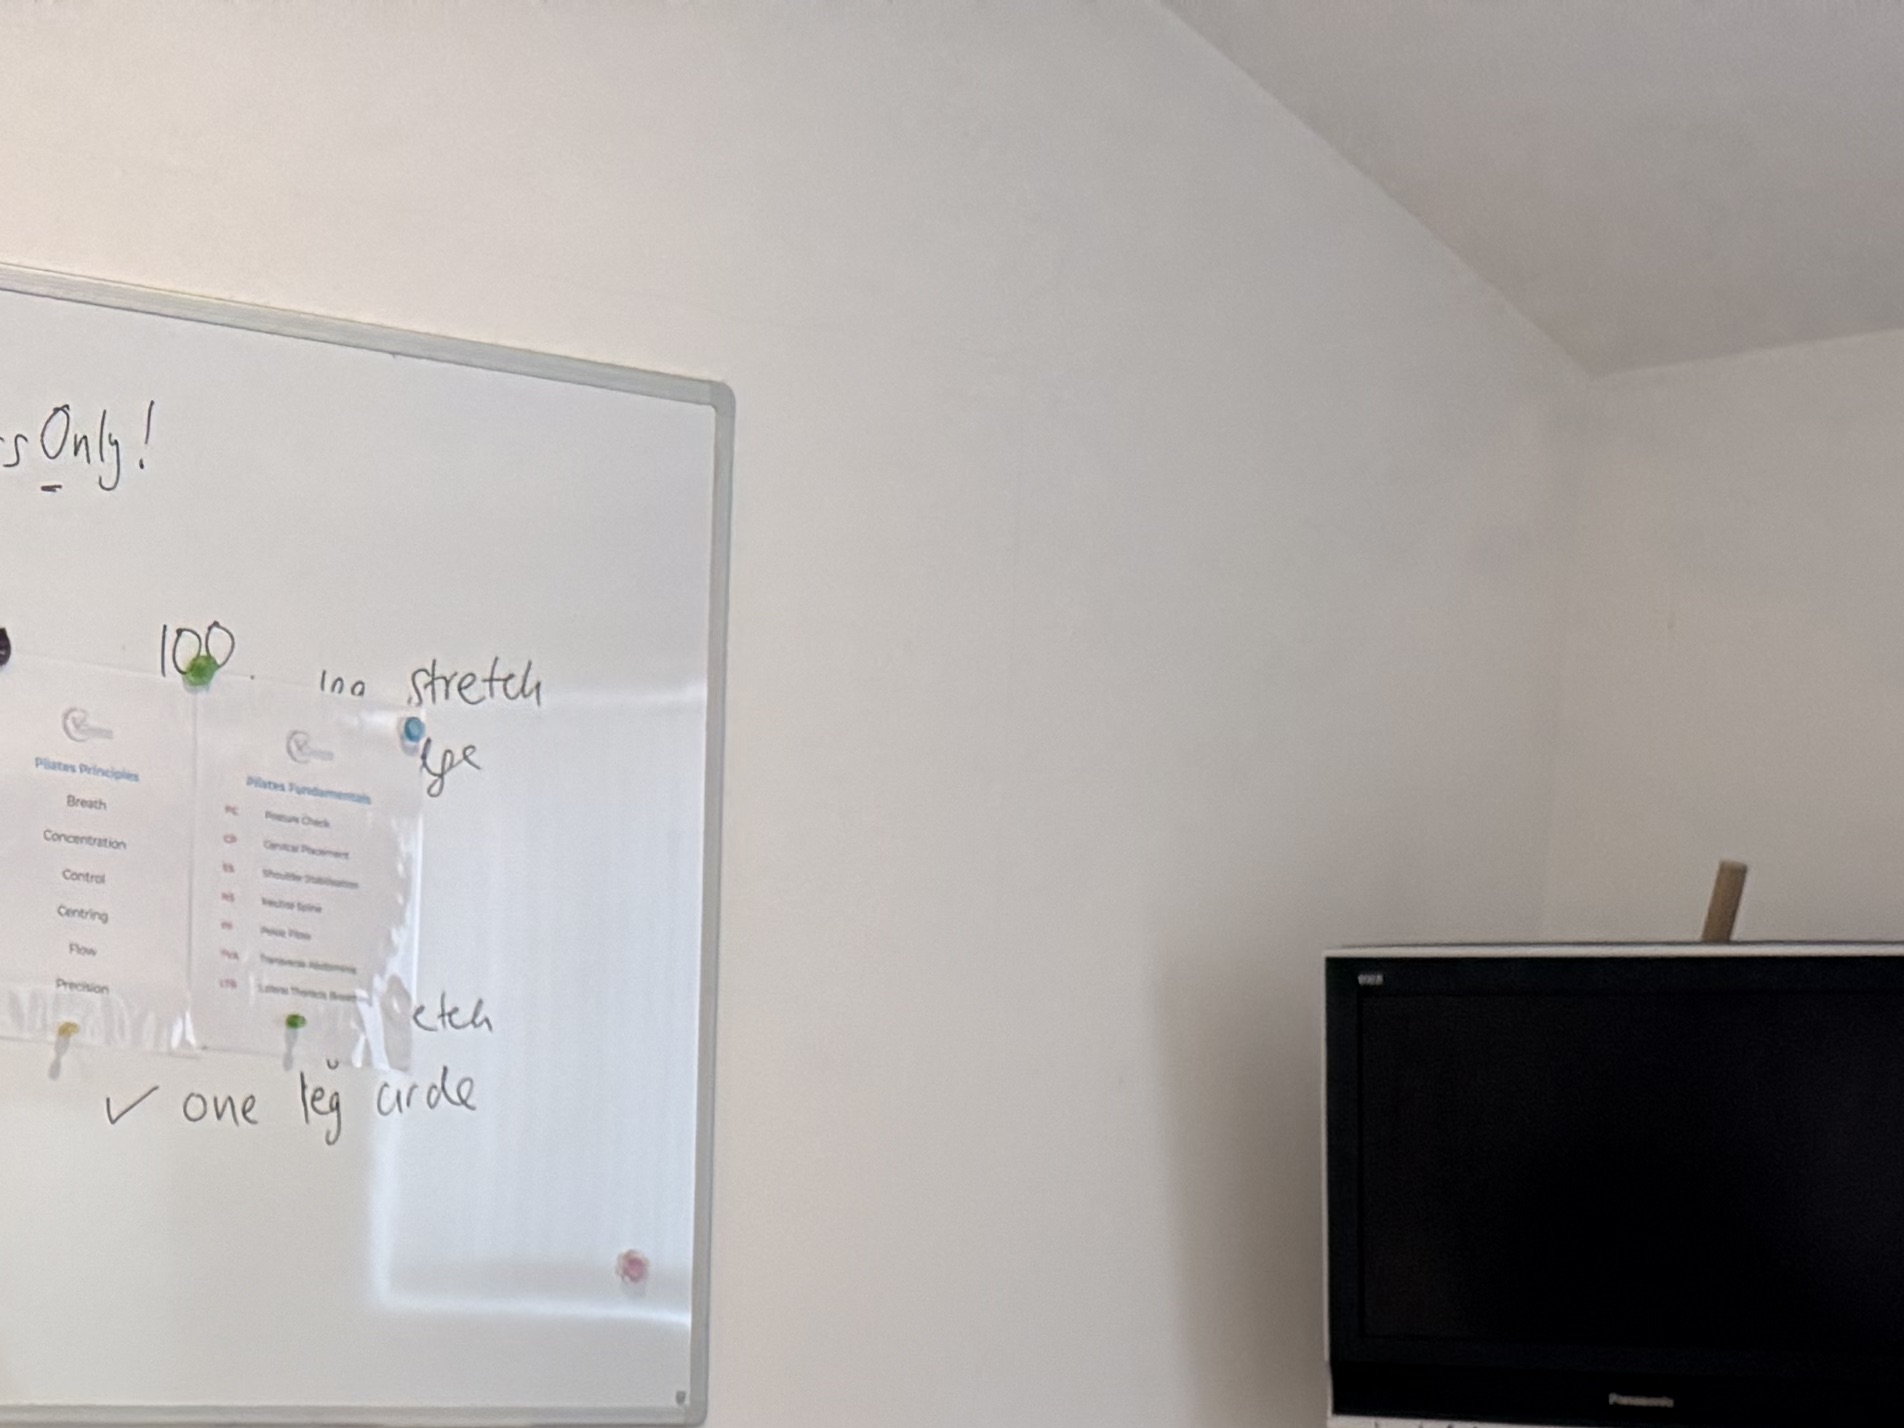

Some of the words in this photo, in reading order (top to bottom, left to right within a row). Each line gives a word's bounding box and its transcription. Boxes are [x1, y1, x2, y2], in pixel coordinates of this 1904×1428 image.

[407, 656, 542, 707] stretch
[35, 757, 76, 773] Pilates
[79, 764, 139, 782] Principles
[246, 776, 285, 793] Pilates
[66, 795, 106, 810] Breath
[43, 829, 127, 850] Concentration
[62, 869, 105, 884] Control
[57, 905, 109, 924] Centring
[69, 943, 97, 957] Flow
[56, 978, 109, 995] Precision
[182, 1090, 258, 1126] one
[300, 1059, 342, 1149] leg
